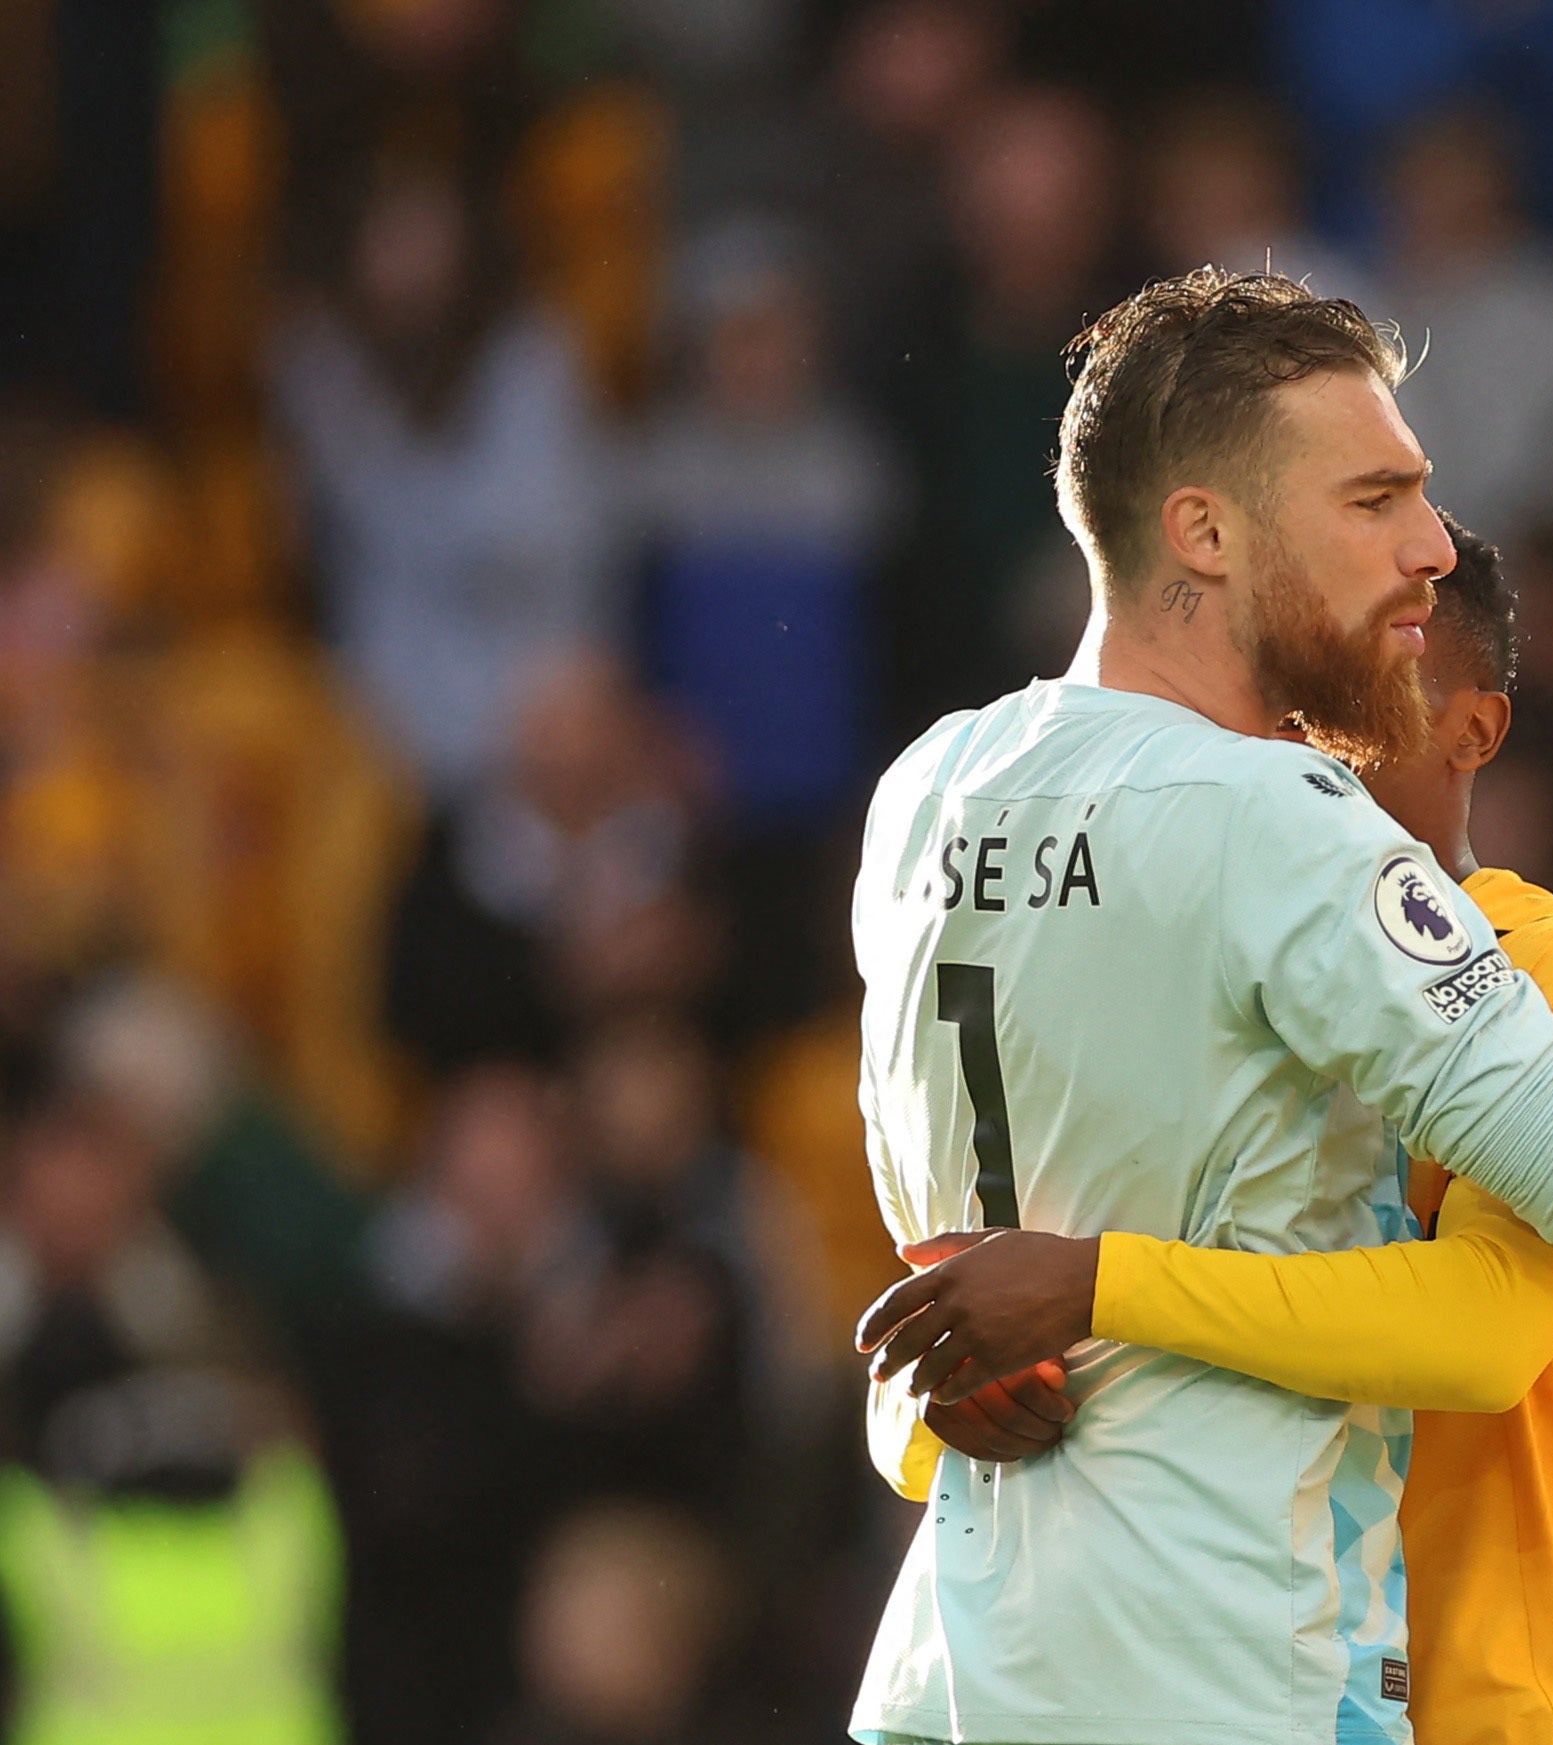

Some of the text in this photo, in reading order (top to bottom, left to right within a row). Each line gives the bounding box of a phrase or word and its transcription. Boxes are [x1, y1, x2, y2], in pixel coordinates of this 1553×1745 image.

[1027, 803, 1101, 908] SÁ
[1423, 984, 1456, 1011] No
[936, 962, 1020, 1230] 1
